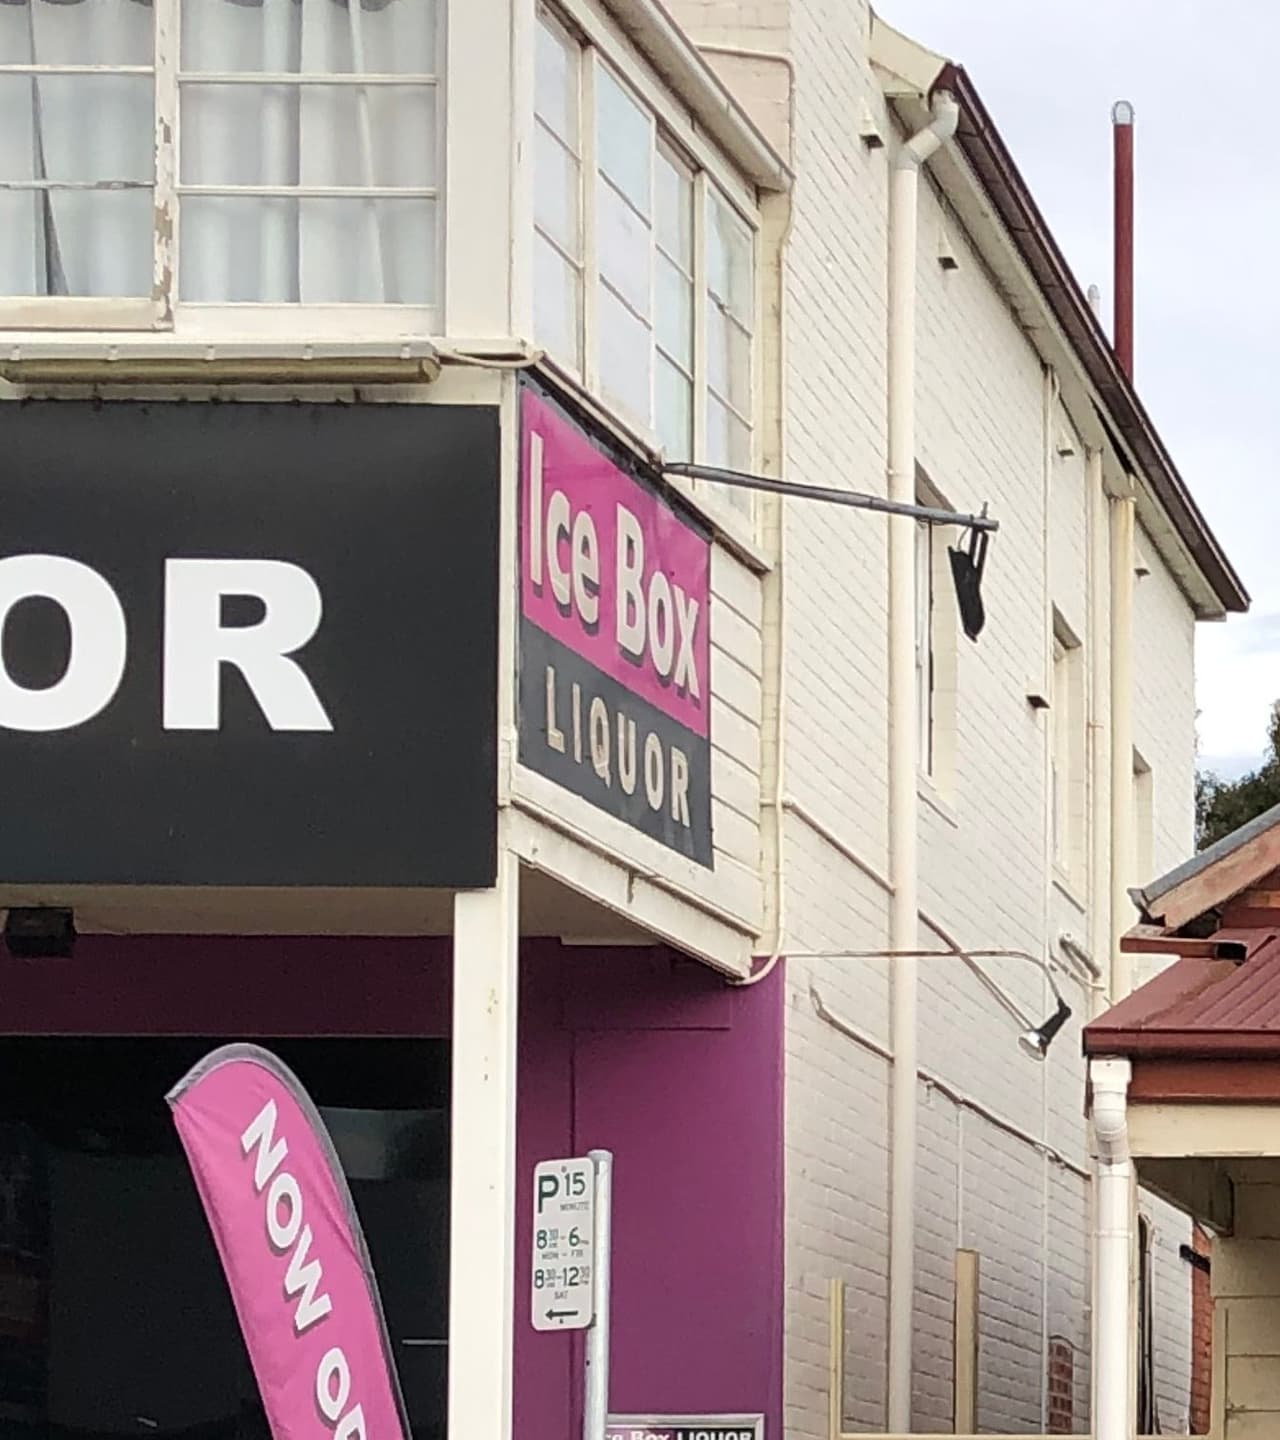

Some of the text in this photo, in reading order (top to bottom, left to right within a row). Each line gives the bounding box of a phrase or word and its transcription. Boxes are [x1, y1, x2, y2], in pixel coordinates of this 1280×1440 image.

[530, 430, 700, 699] Ice Box
[546, 666, 690, 828] LIQUOR
[241, 1098, 333, 1331] NOW
[537, 1172, 586, 1214] P 15
